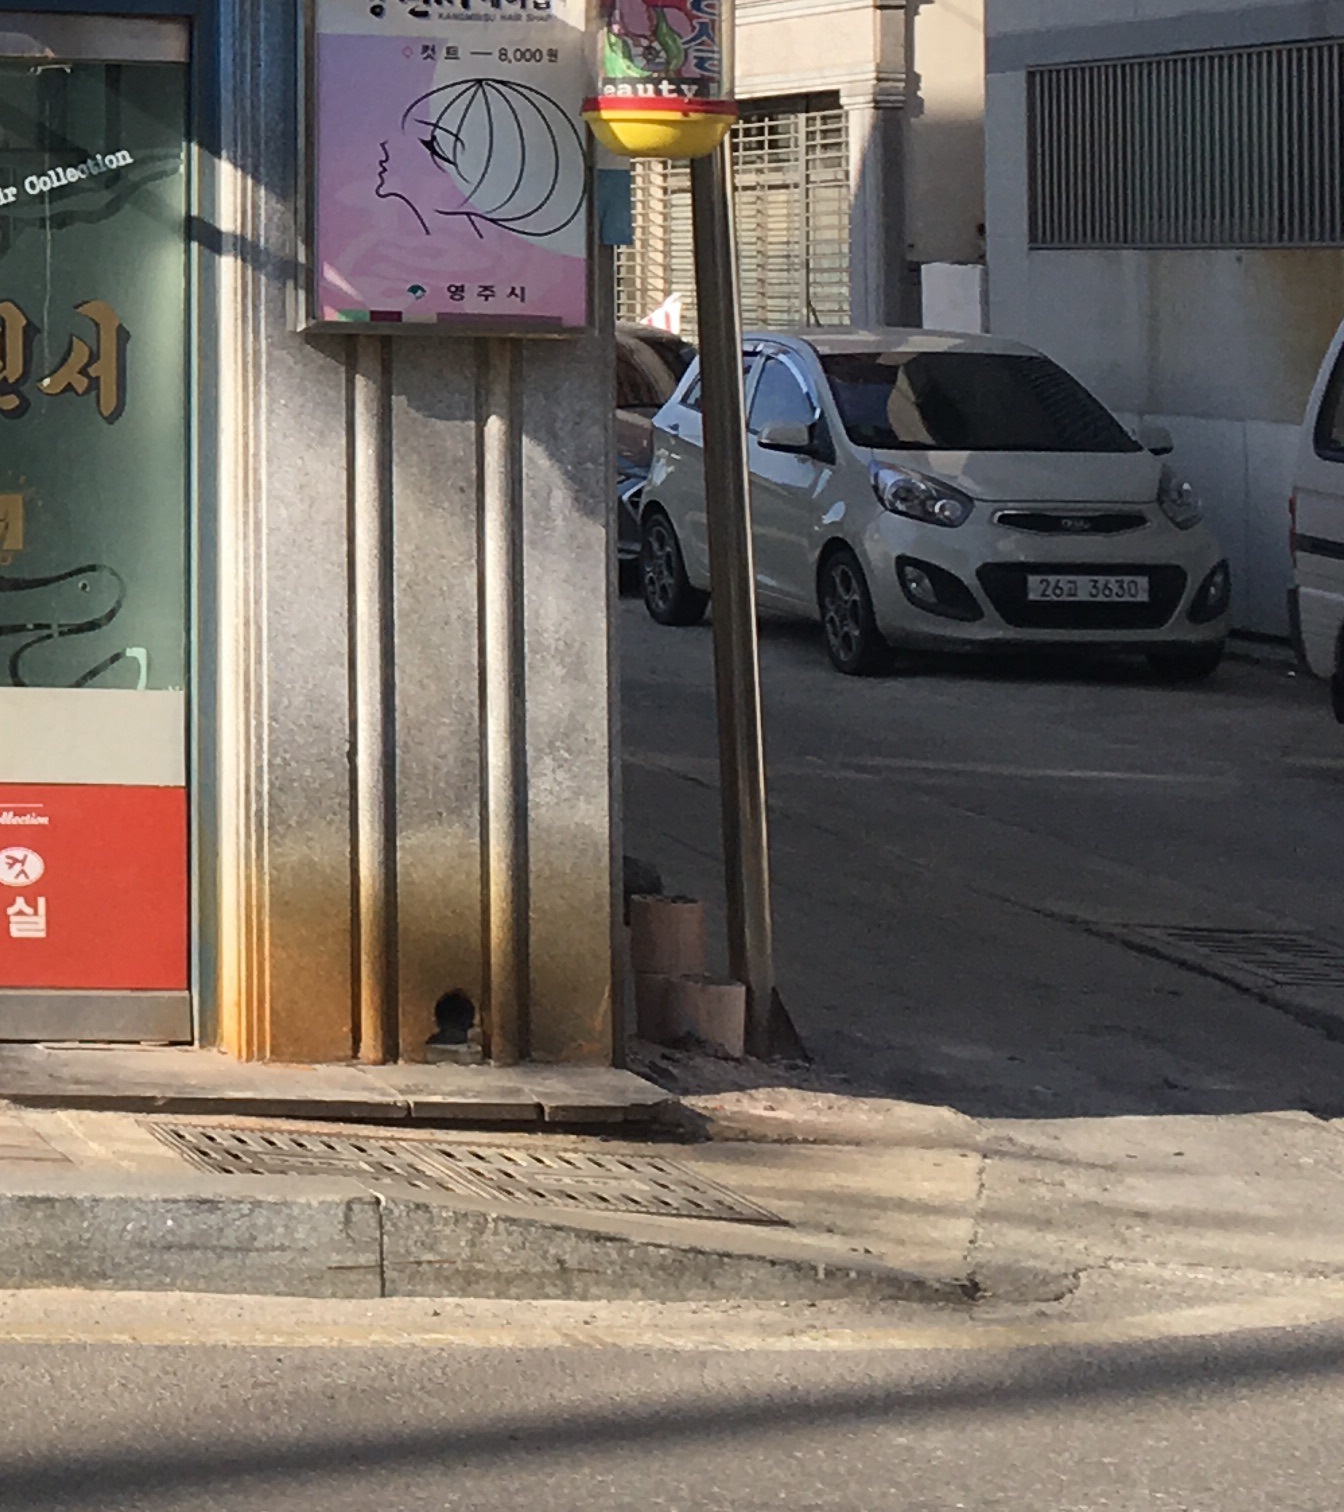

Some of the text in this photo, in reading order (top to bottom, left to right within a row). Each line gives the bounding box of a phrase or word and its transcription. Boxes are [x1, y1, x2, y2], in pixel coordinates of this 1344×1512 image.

[23, 148, 134, 198] Collection
[446, 282, 527, 303] 영주시
[1088, 579, 1139, 599] 3630
